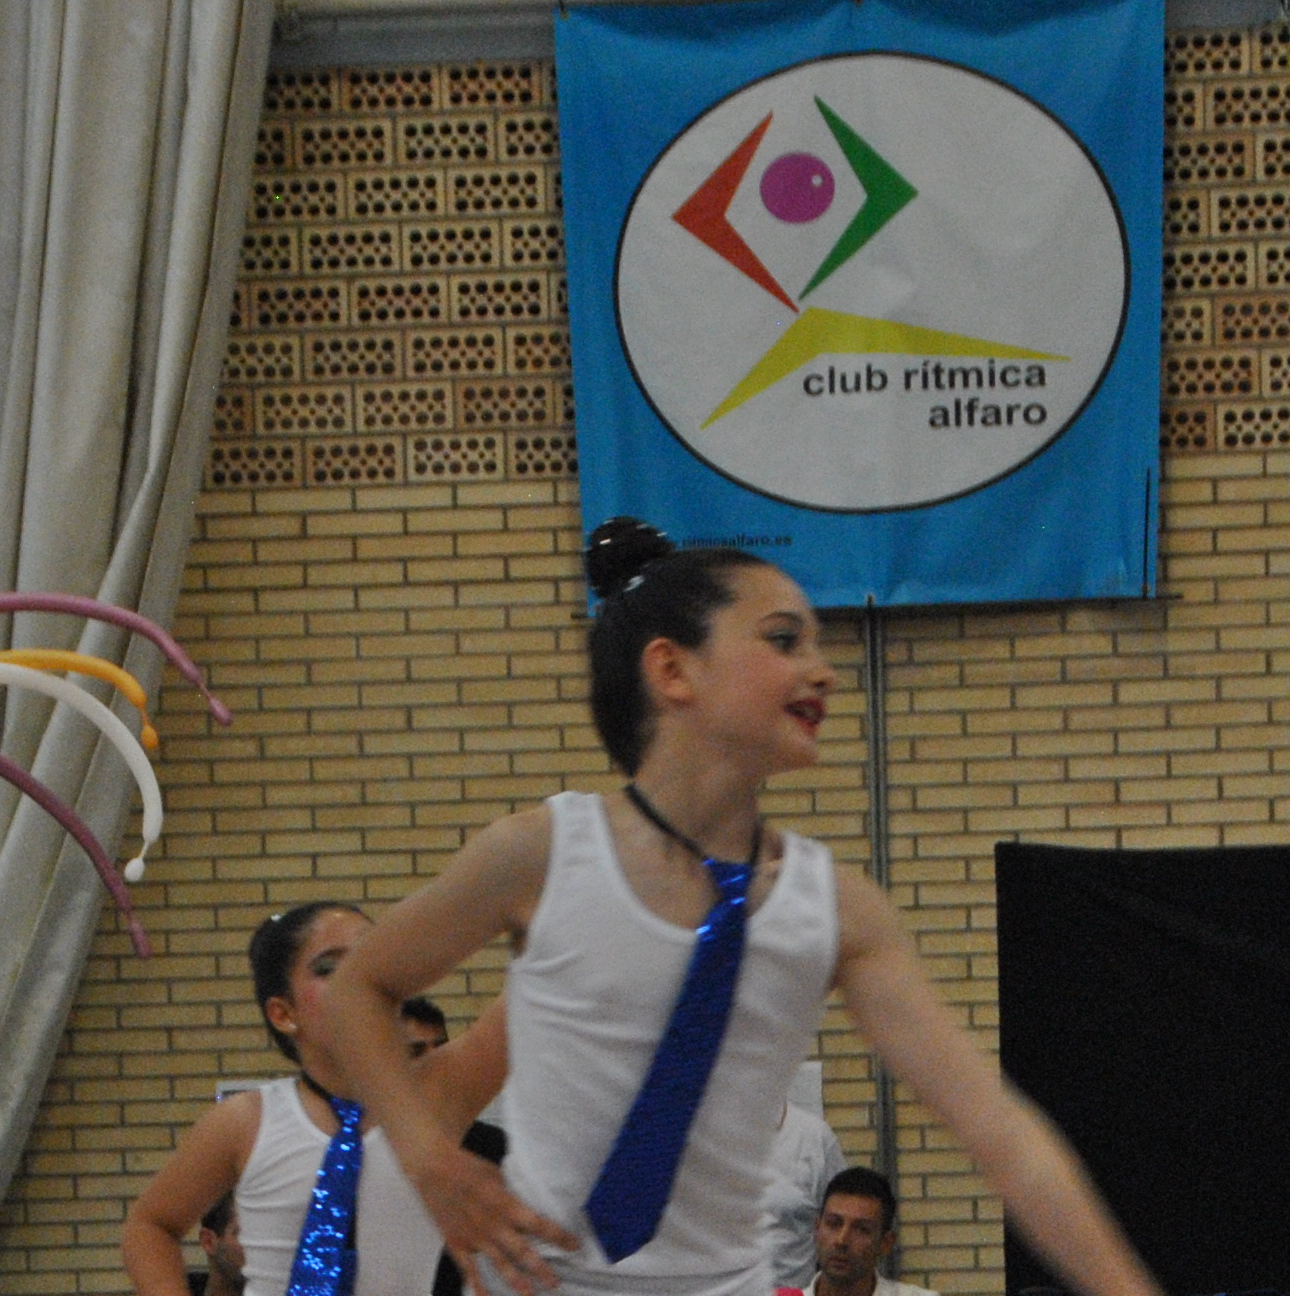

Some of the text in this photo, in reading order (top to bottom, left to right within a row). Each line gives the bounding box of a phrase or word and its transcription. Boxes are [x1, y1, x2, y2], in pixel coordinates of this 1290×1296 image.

[802, 359, 1047, 396] club rítmica
[928, 398, 1048, 429] alfaro
